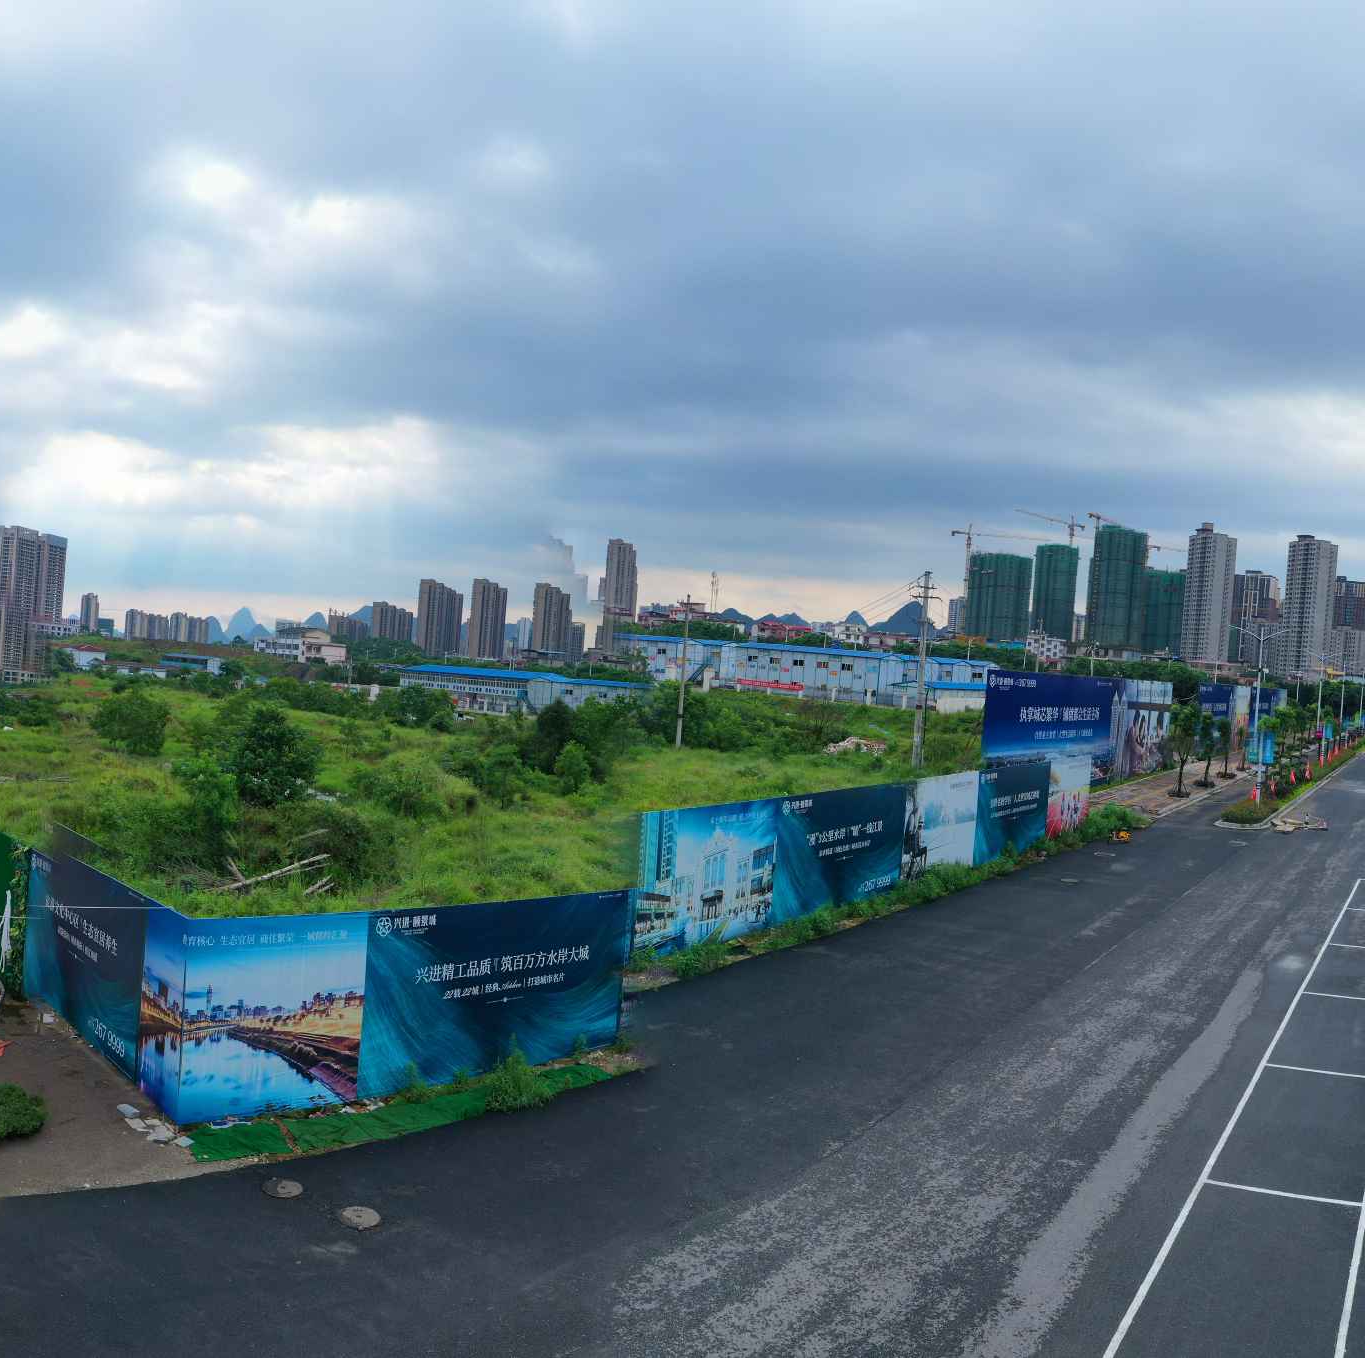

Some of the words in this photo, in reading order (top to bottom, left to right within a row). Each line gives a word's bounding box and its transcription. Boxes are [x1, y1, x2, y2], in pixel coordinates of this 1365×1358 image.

[415, 958, 492, 985] 兴进精工品质
[500, 945, 590, 972] 筑百万方水岸大城
